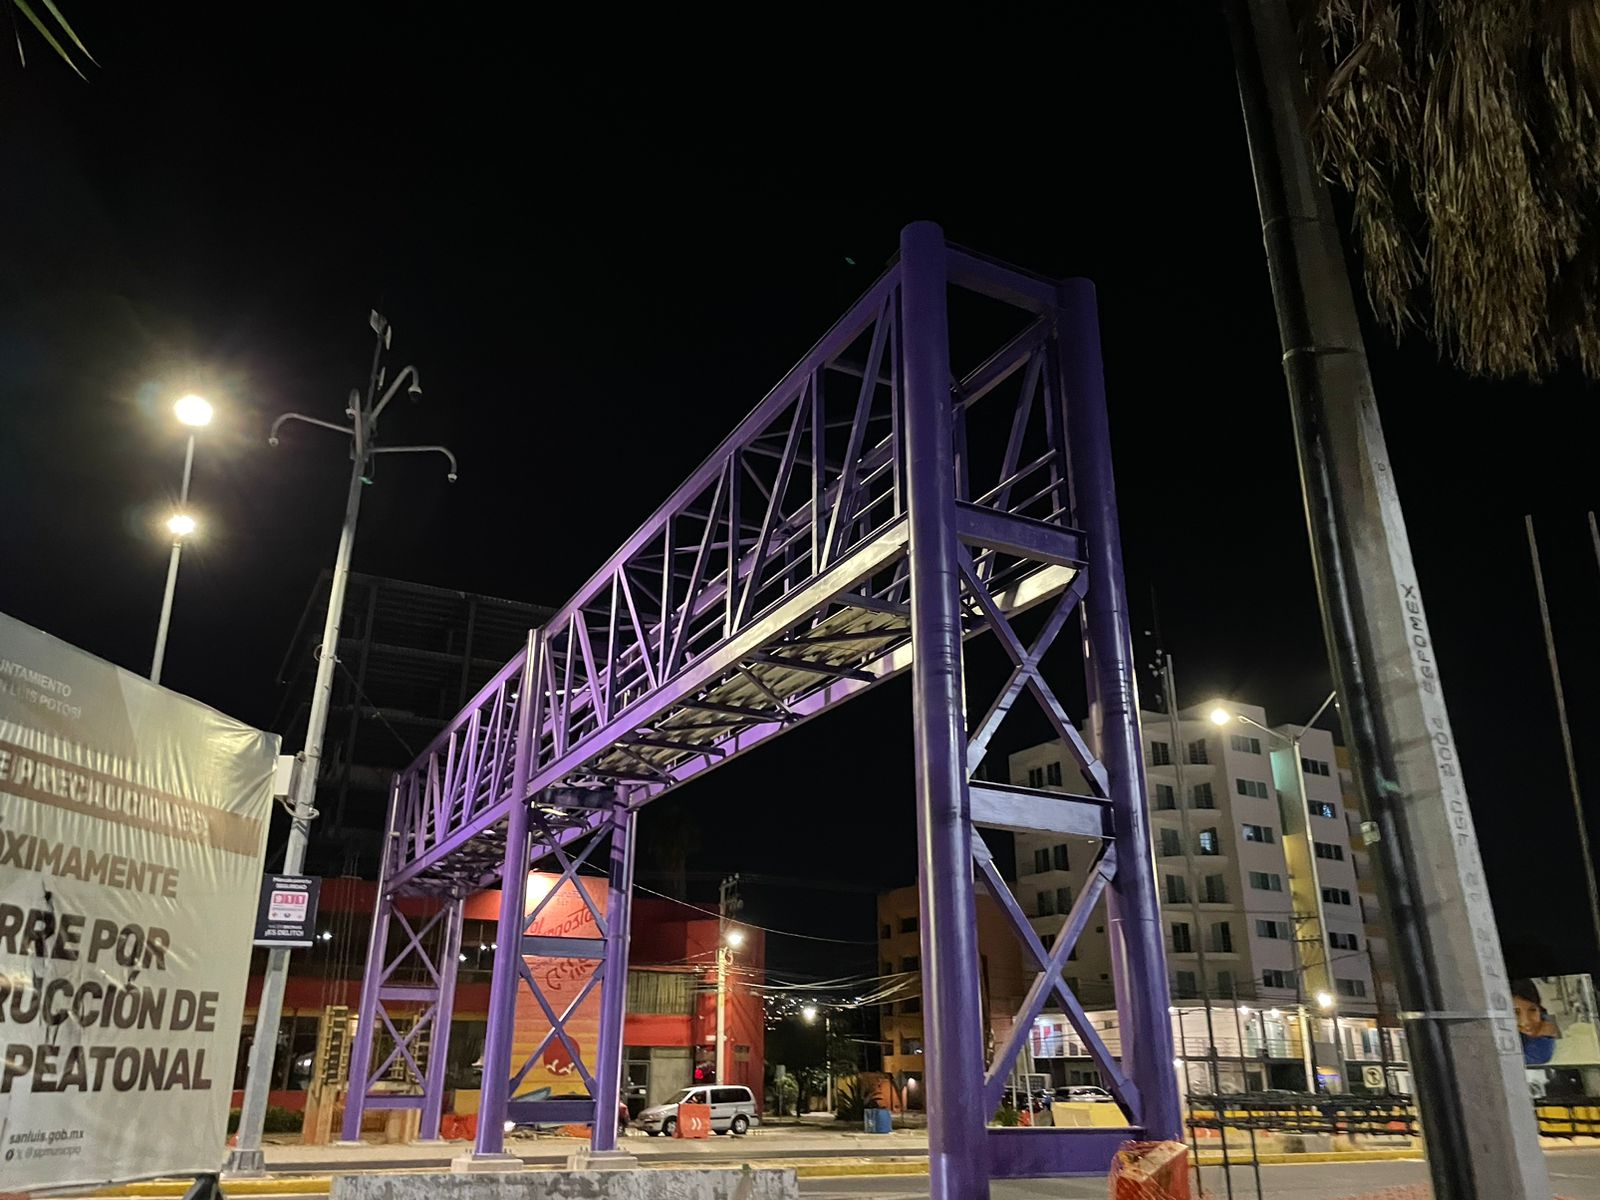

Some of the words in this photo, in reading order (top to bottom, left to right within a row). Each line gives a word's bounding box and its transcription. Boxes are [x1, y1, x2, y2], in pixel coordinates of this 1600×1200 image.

[0, 827, 180, 898] XIMAMENTE
[87, 918, 171, 971] POR
[169, 989, 219, 1032] DE
[0, 1043, 212, 1093] PEATONAL
[9, 1127, 84, 1145] sanluis.gob.mx
